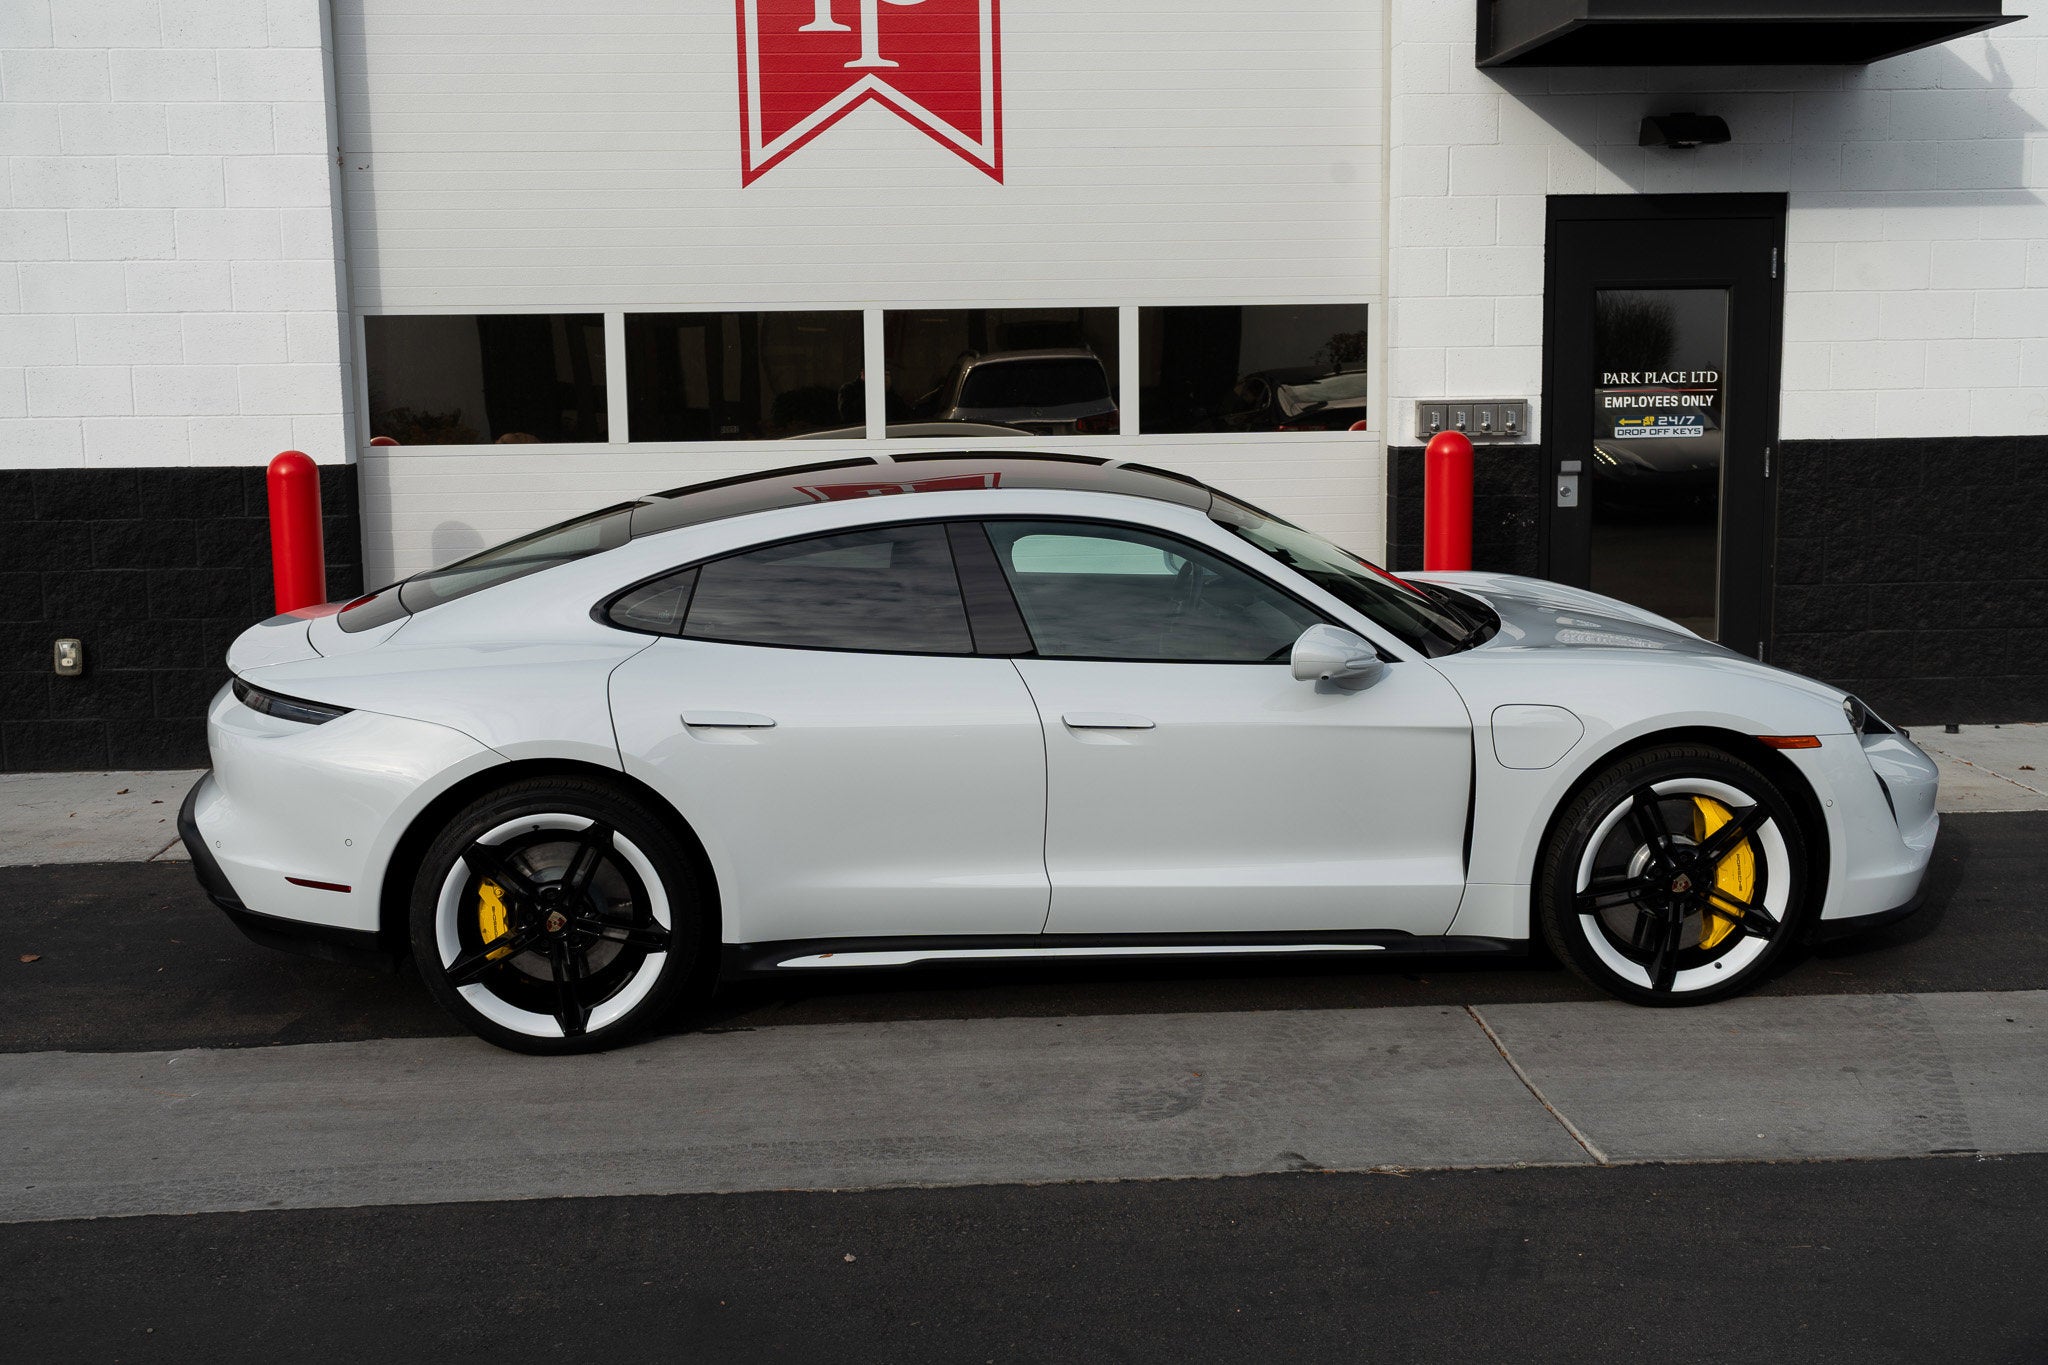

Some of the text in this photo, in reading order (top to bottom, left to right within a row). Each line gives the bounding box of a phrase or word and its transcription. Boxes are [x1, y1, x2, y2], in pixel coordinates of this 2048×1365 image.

[1602, 371, 1718, 384] PARK PLACE LTD
[1604, 394, 1714, 408] EMPLOYEES ONLY
[1658, 416, 1695, 425] 24/7
[1617, 427, 1701, 436] DROP OFF KEYS
